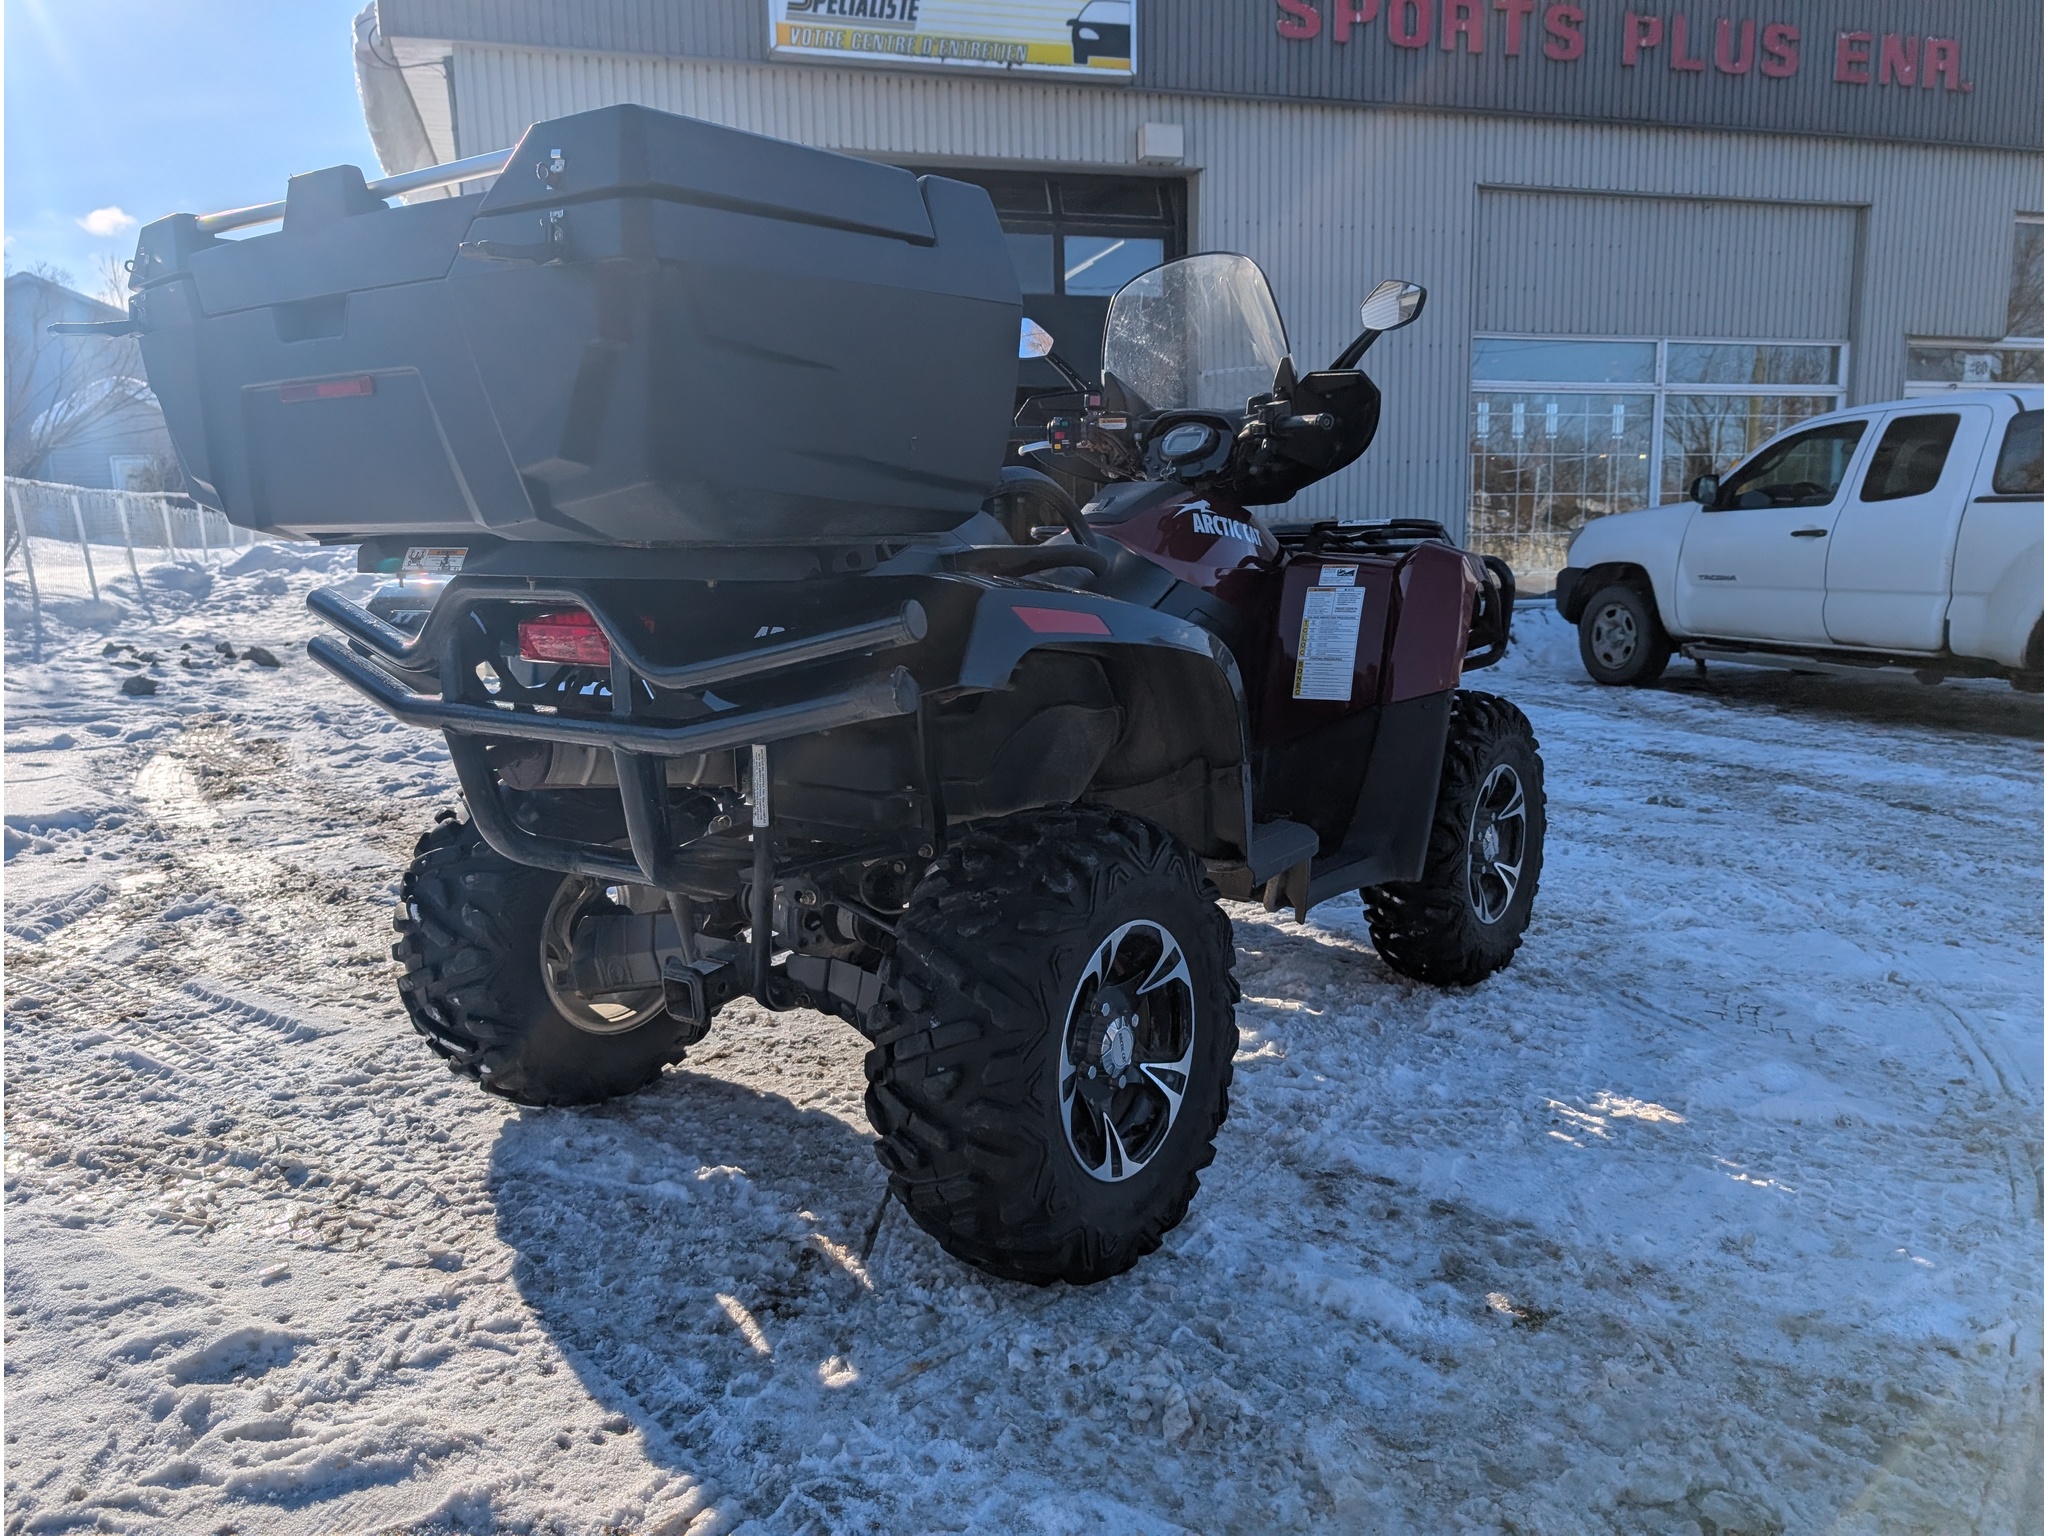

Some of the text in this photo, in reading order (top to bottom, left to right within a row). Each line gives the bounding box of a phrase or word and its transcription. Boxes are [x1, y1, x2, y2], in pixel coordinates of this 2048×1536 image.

[790, 27, 845, 48] VOTRE
[851, 31, 916, 54] CENTRE
[1276, 0, 1585, 60] SPORTS
[1621, 11, 1800, 77] PLUS
[1193, 513, 1263, 547] ARCTIC CAT
[390, 612, 420, 624] XT
